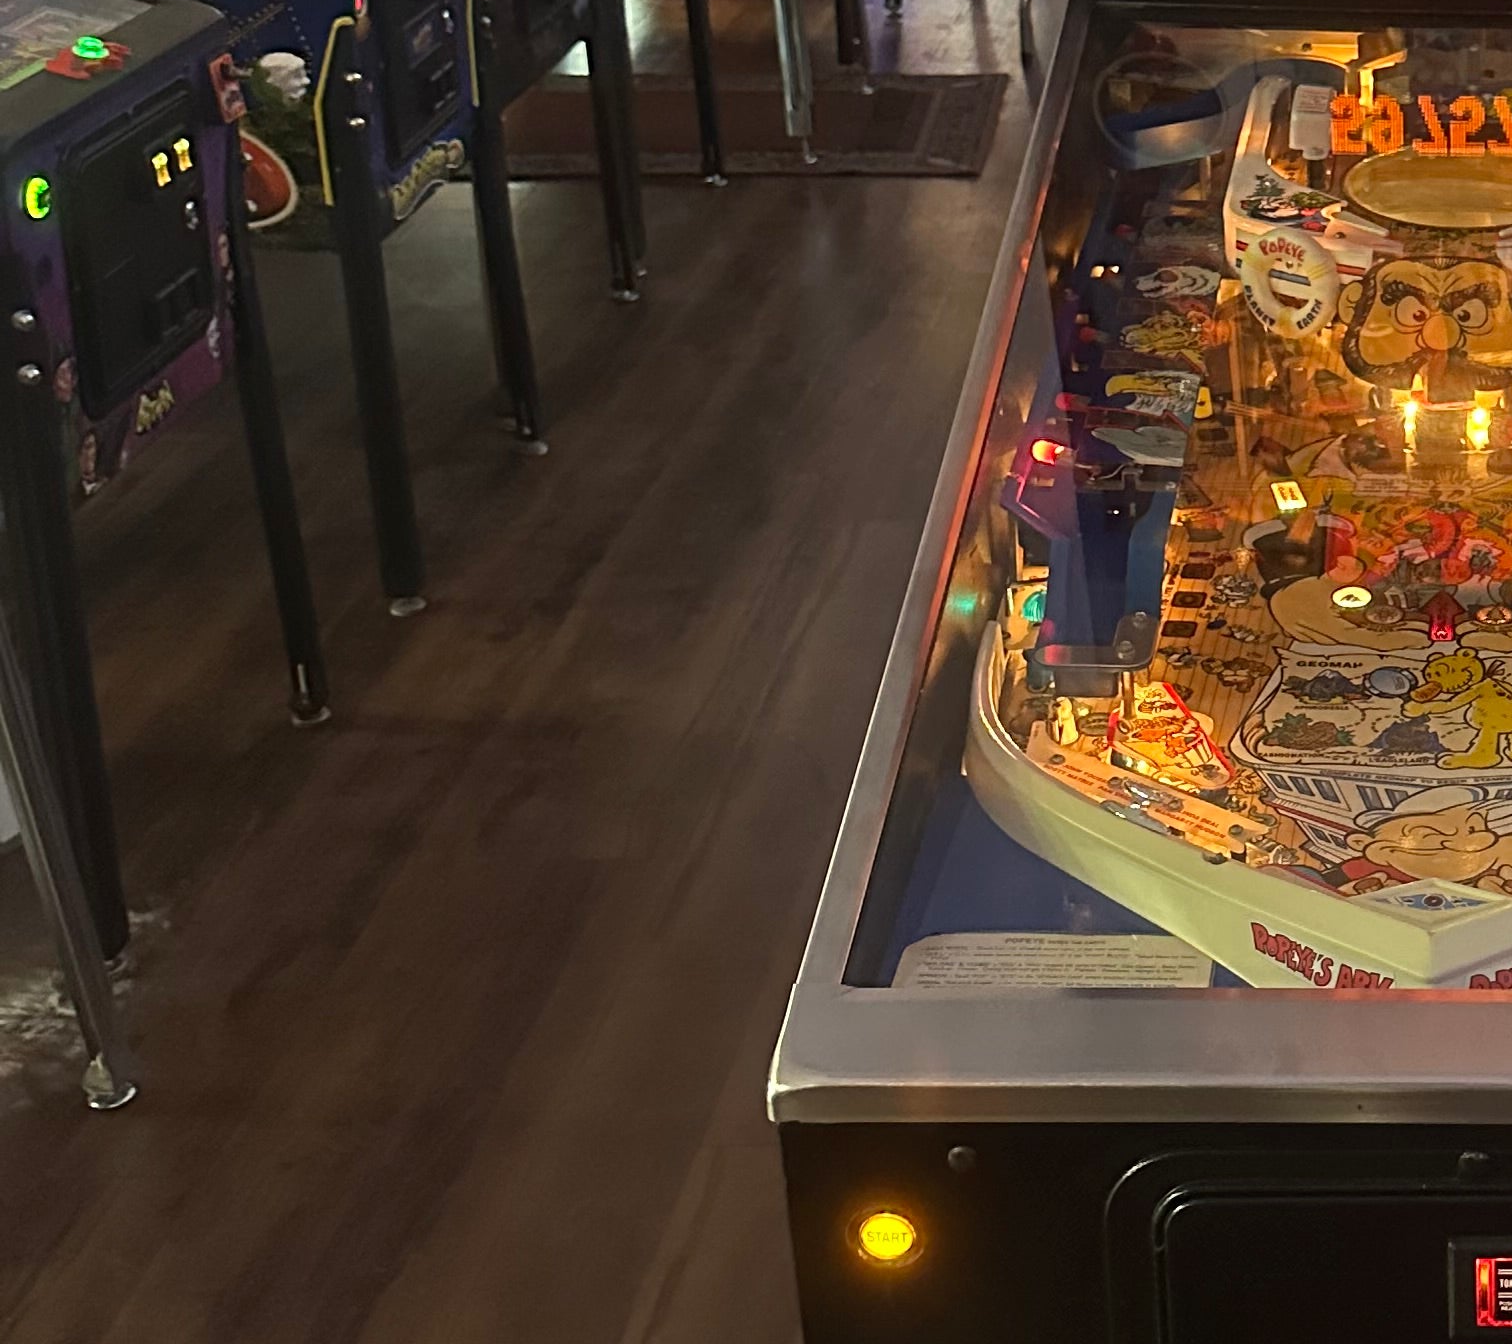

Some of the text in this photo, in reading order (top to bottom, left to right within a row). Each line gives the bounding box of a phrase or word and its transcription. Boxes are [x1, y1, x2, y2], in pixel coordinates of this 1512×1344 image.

[1259, 237, 1306, 262] POPEYE
[1296, 660, 1364, 669] GEOMAP
[1005, 937, 1046, 945] POPEYE
[1249, 922, 1333, 987] POPEYE'S
[867, 1232, 908, 1243] START
